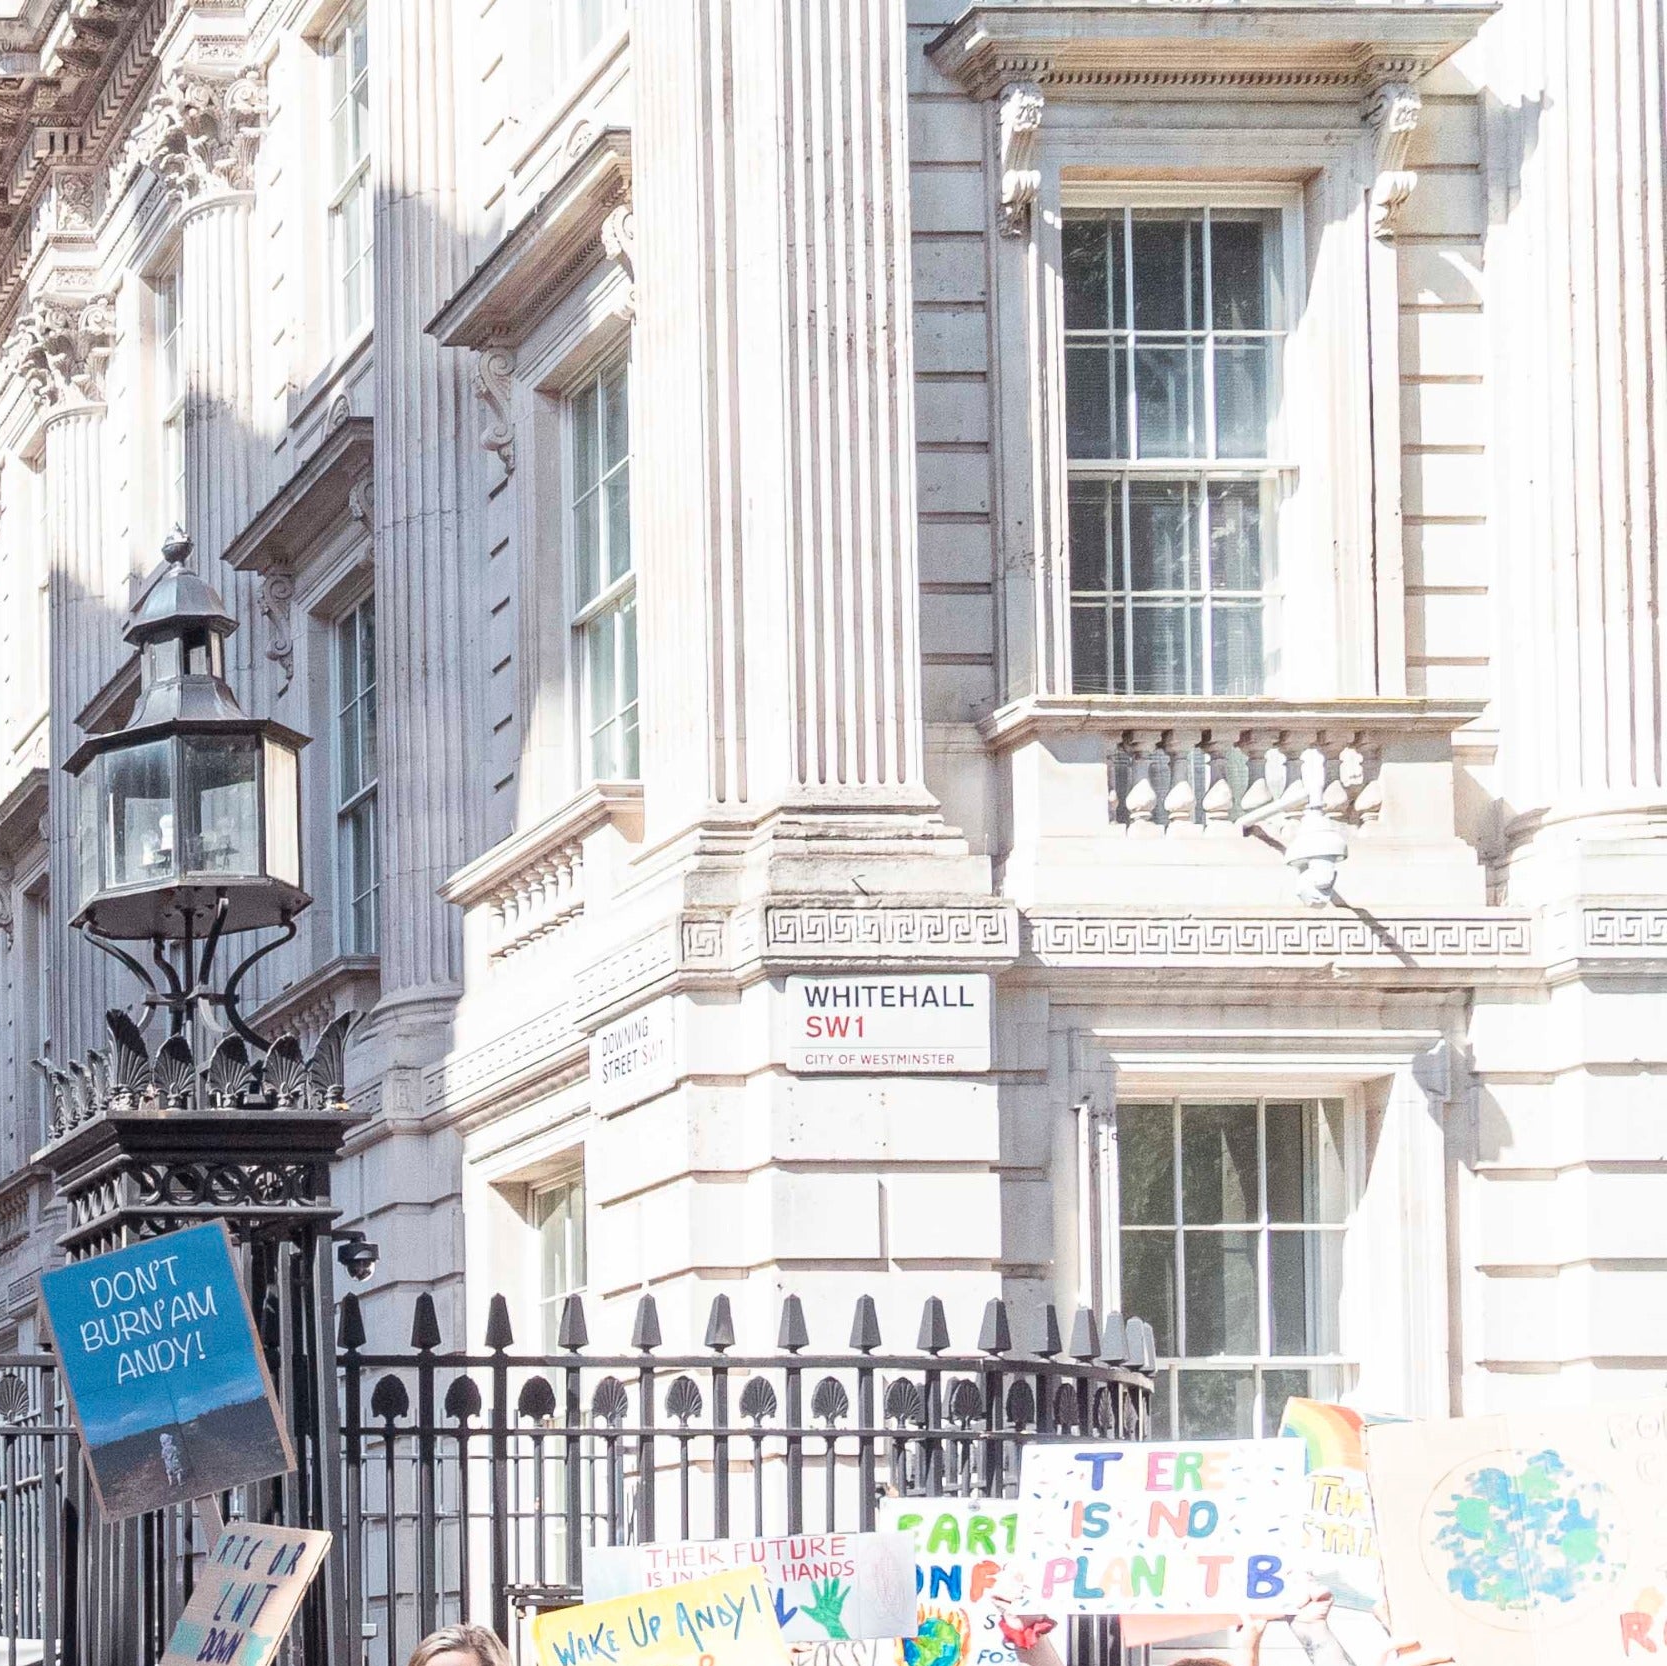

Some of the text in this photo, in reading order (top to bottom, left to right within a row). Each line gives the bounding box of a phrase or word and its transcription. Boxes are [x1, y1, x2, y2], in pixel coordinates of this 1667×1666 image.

[804, 985, 975, 1008] WHITEHALL
[602, 1015, 650, 1058] DOWNING
[805, 1015, 864, 1038] SW1
[601, 1048, 638, 1085] STREET
[805, 1053, 956, 1066] CITY OF WESTMINSTER
[89, 1254, 179, 1310] DON'T
[116, 1329, 207, 1386] ANDY!
[1073, 1449, 1230, 1493] TERE
[1070, 1498, 1220, 1540] IS NO
[644, 1534, 849, 1570] THEIR FUTURE
[780, 1558, 856, 1584] HANDS
[1246, 1552, 1286, 1600] B
[675, 1583, 764, 1654] ANDY!
